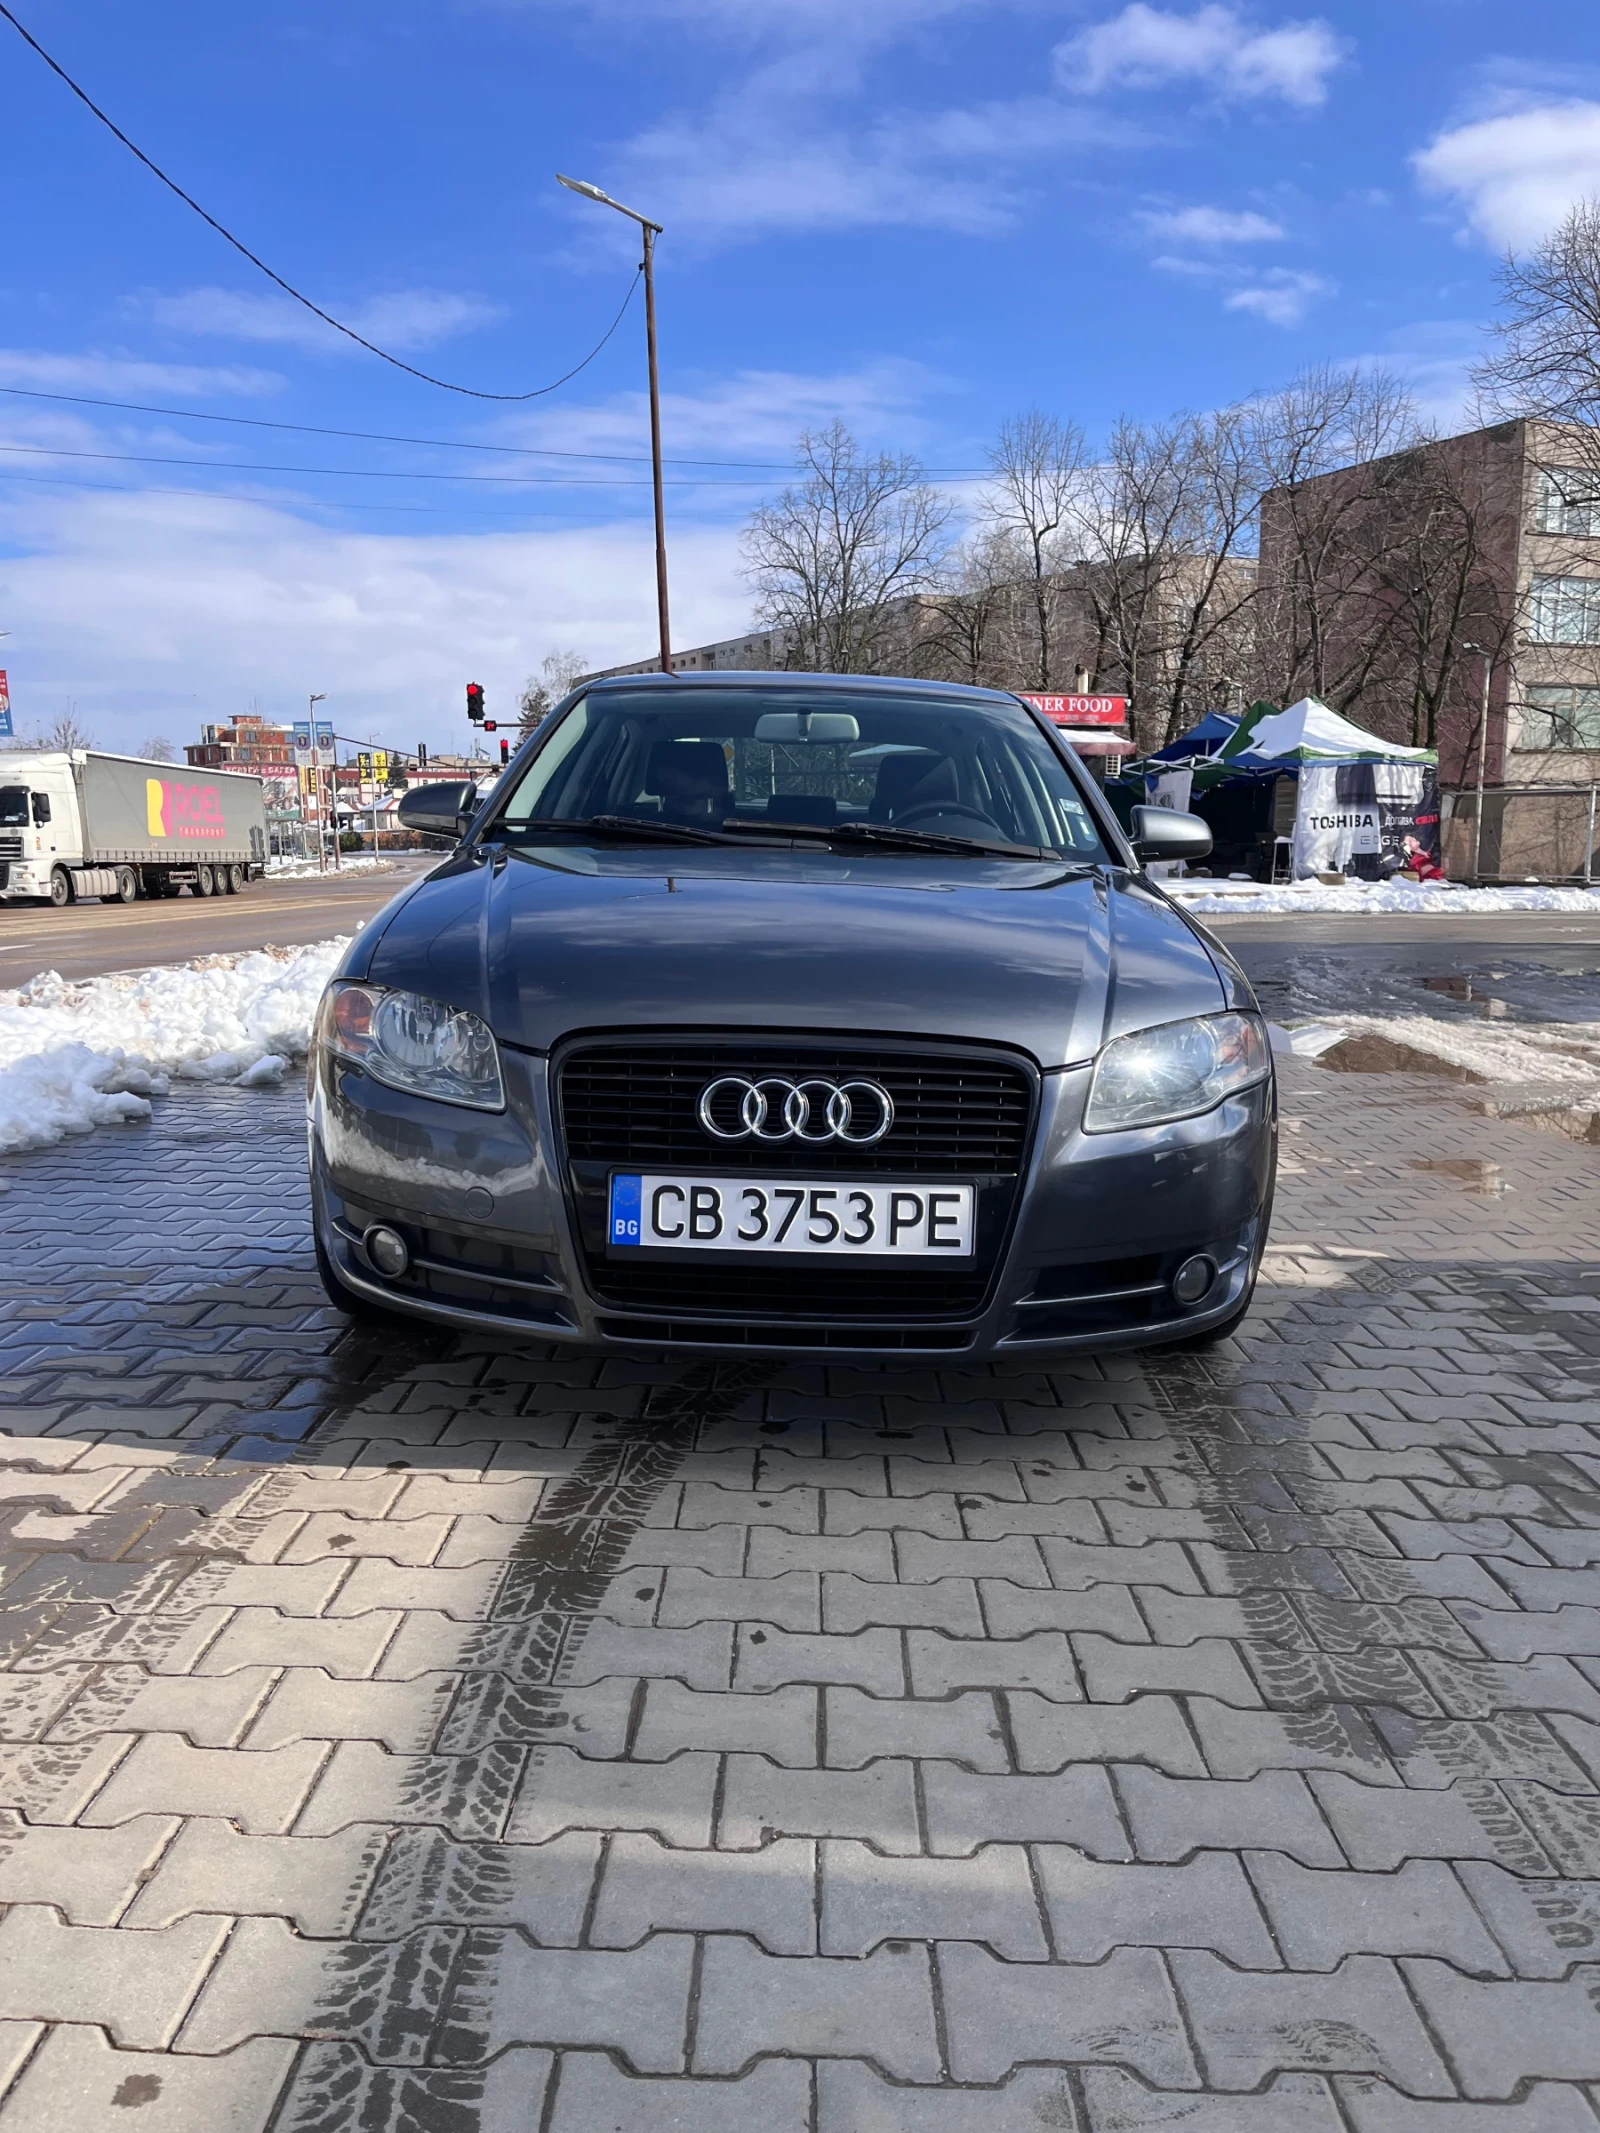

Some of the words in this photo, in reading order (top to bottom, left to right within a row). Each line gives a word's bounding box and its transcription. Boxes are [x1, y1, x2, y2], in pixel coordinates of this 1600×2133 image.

[1068, 697, 1112, 712] FOOD
[175, 783, 225, 823] ROEL
[1310, 814, 1374, 830] TOSHIBA
[180, 827, 224, 837] TRANSPORT
[651, 1185, 724, 1239] CB
[738, 1187, 875, 1244] 3753
[890, 1192, 961, 1247] PE
[615, 1219, 638, 1236] BG
